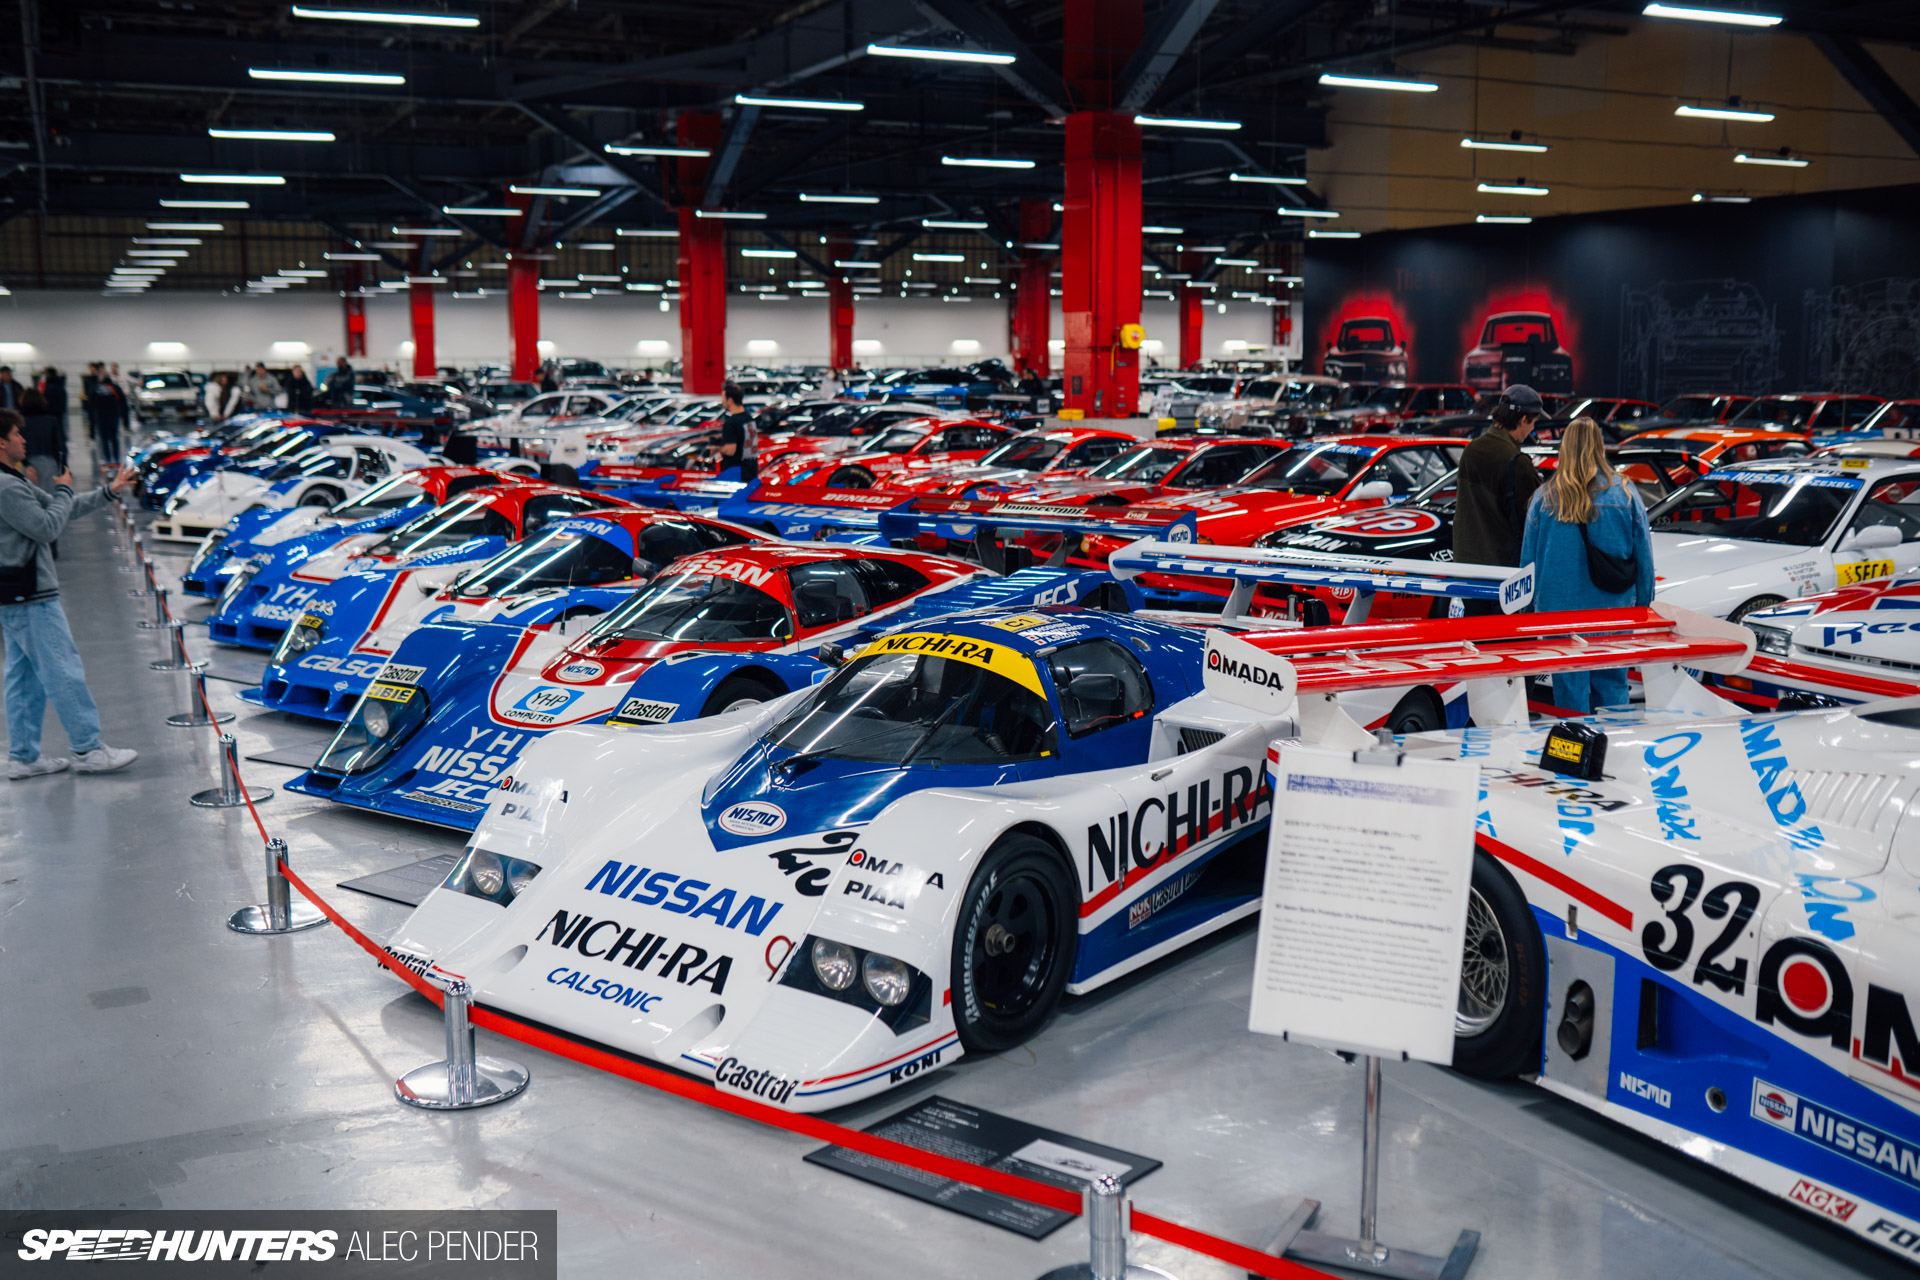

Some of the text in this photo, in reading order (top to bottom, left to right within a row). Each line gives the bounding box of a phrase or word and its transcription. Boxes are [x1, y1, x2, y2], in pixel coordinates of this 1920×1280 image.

[821, 493, 894, 504] DUNLOP
[785, 524, 810, 534] JECS
[1170, 530, 1189, 543] NISMO
[1032, 579, 1080, 606] JECS
[1505, 574, 1532, 605] NISMO
[878, 637, 995, 665] NICHI-RA
[380, 665, 424, 682] Castrol
[563, 665, 600, 676] NISMO
[530, 692, 569, 707] YHP
[621, 700, 676, 720] Castrol
[503, 710, 555, 724] COMPUTER
[403, 791, 484, 813] BRIDGESTONE
[728, 807, 780, 827] NISMO
[1087, 757, 1275, 894] NICHI-RA
[584, 859, 784, 937] NISSAN
[1642, 863, 1760, 997] 32
[535, 909, 734, 996] NICHI-RA
[546, 966, 663, 1014] CALSONIC
[715, 1056, 798, 1105] Castrol
[889, 1049, 942, 1085] KONI
[1620, 1071, 1672, 1109] NISMO
[1760, 1096, 1793, 1118] NISSAN
[1801, 1106, 1920, 1181] NISSAN
[1791, 1180, 1842, 1220] NGK
